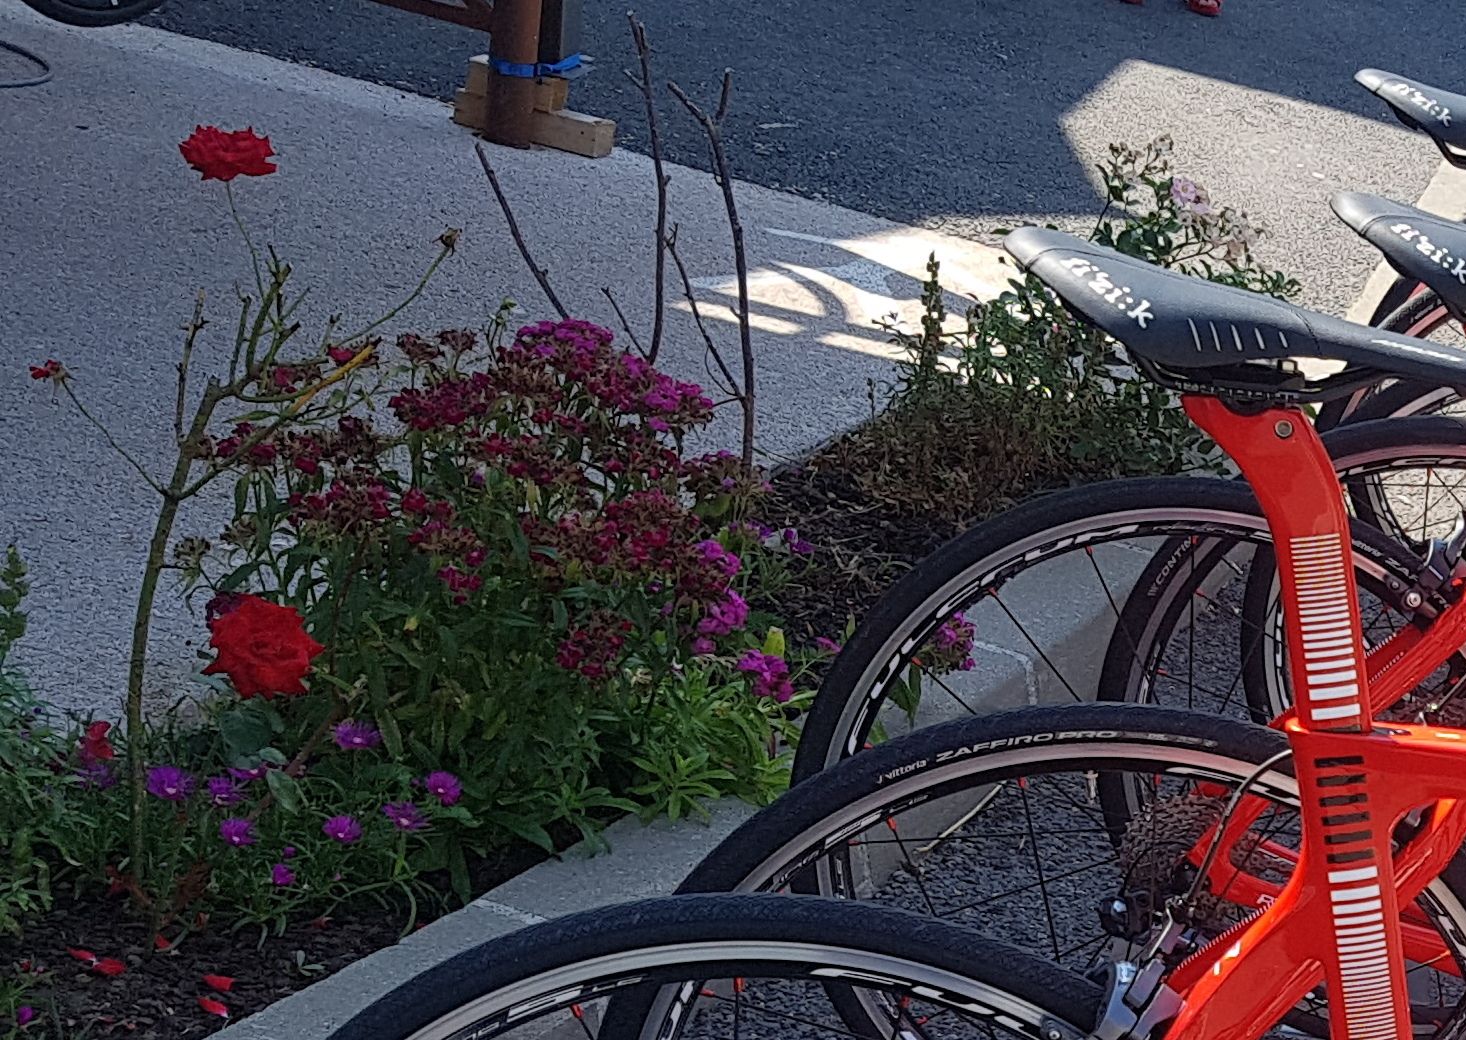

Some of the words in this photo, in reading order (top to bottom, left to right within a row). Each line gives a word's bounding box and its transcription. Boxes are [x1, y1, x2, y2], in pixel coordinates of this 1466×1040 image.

[1154, 536, 1193, 585] CONTIN
[935, 731, 1054, 763] ZAFFIRO
[1056, 729, 1119, 741] PRO
